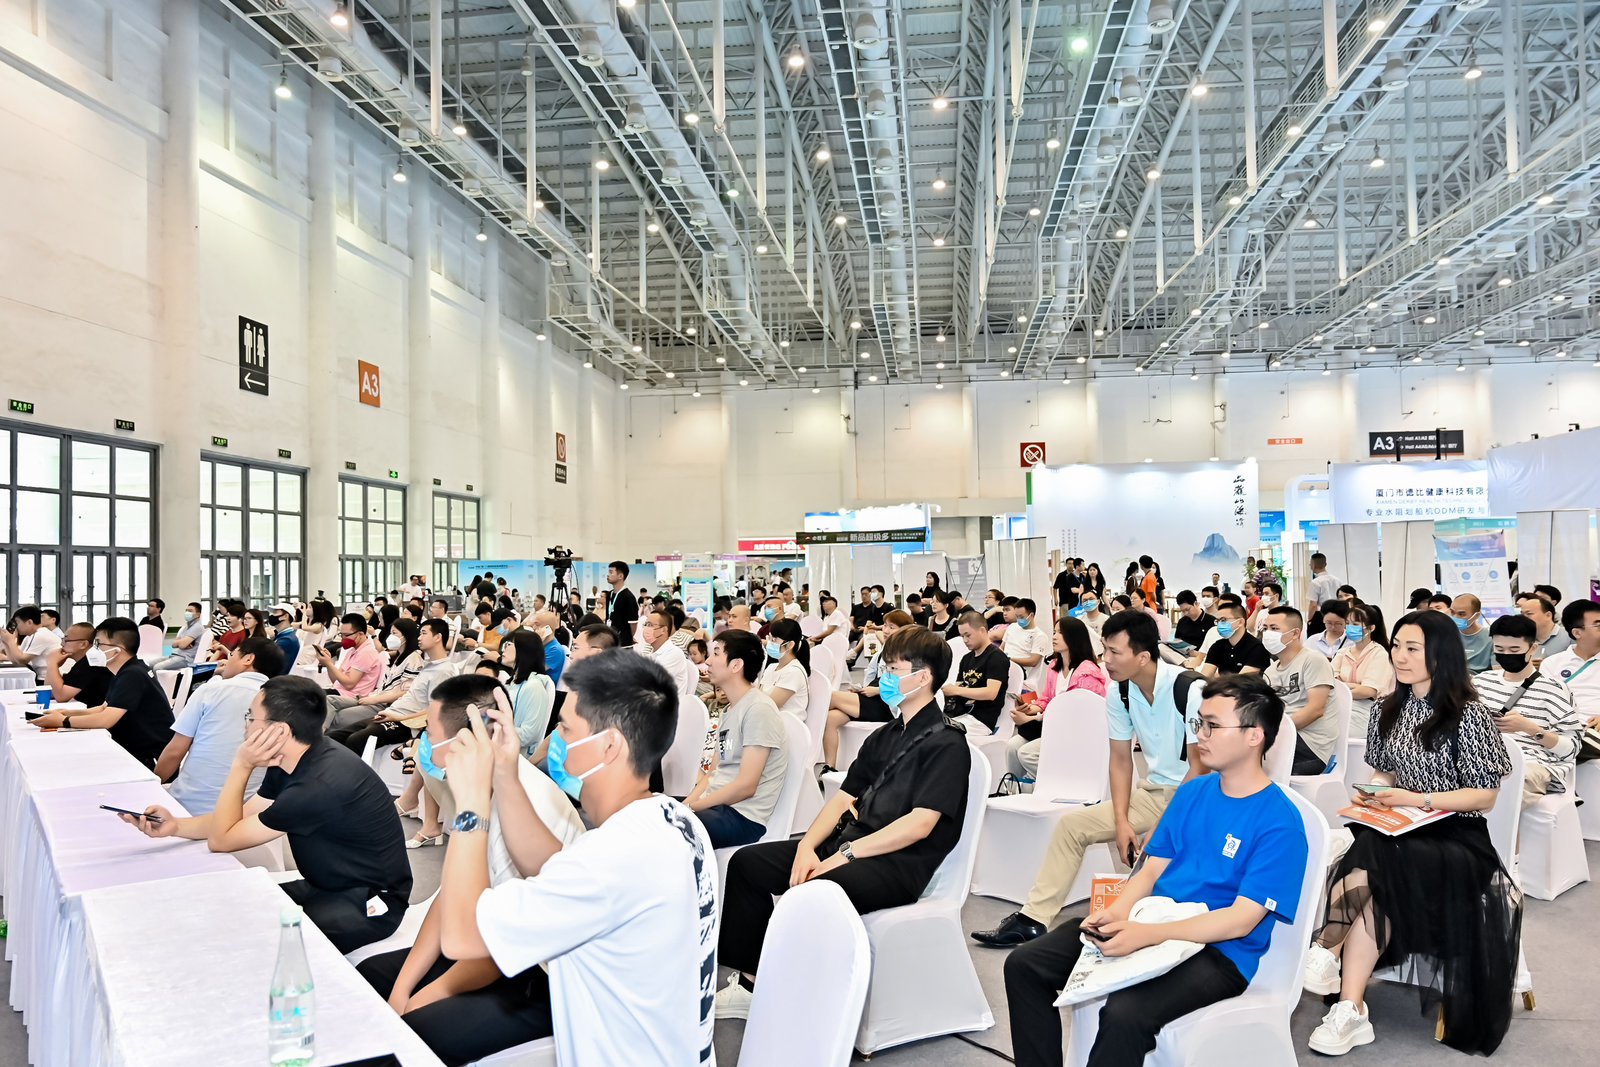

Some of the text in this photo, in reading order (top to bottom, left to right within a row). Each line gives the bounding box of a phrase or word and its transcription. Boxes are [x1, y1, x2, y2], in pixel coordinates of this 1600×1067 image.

[362, 371, 379, 397] A3
[1373, 436, 1395, 451] A3
[1376, 487, 1488, 498] 厦门市德比健康科技有限
